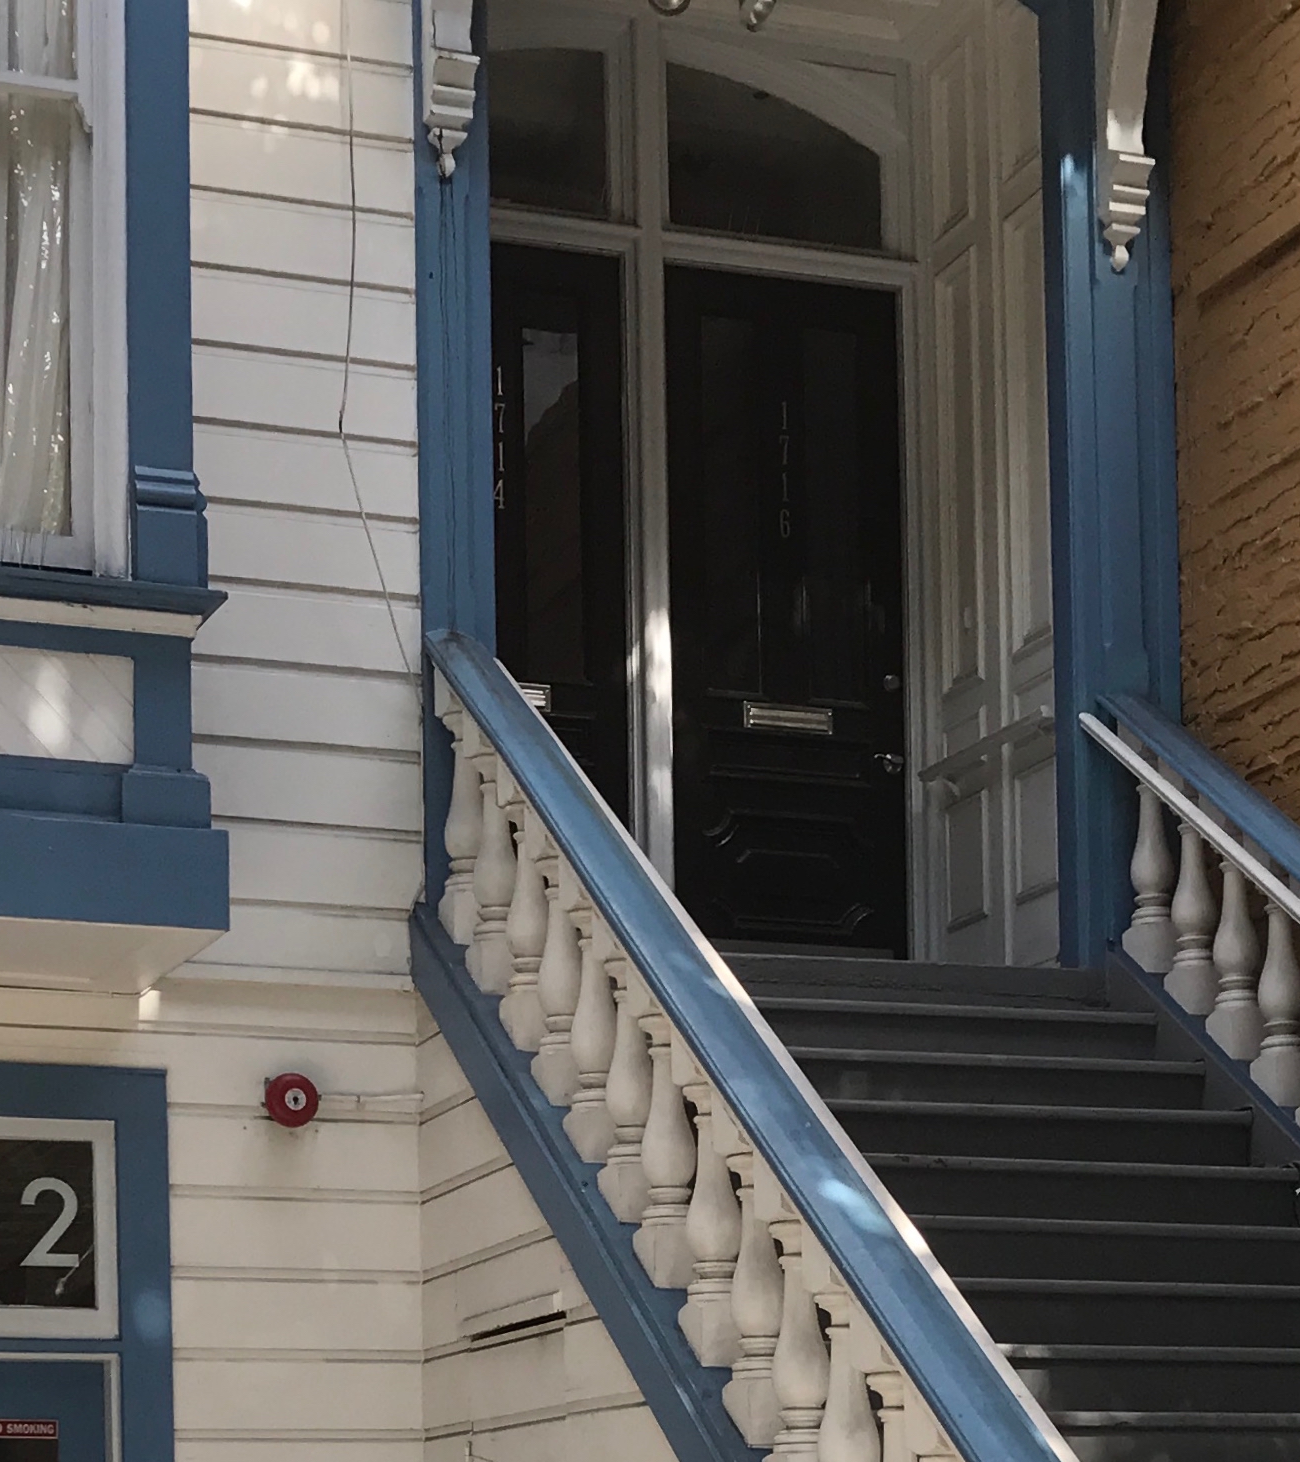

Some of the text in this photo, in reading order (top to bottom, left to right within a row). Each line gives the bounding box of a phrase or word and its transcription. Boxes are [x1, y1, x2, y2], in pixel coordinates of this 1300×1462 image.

[492, 366, 506, 509] 1714
[778, 400, 791, 539] 1716
[6, 1423, 55, 1435] SMOKING
